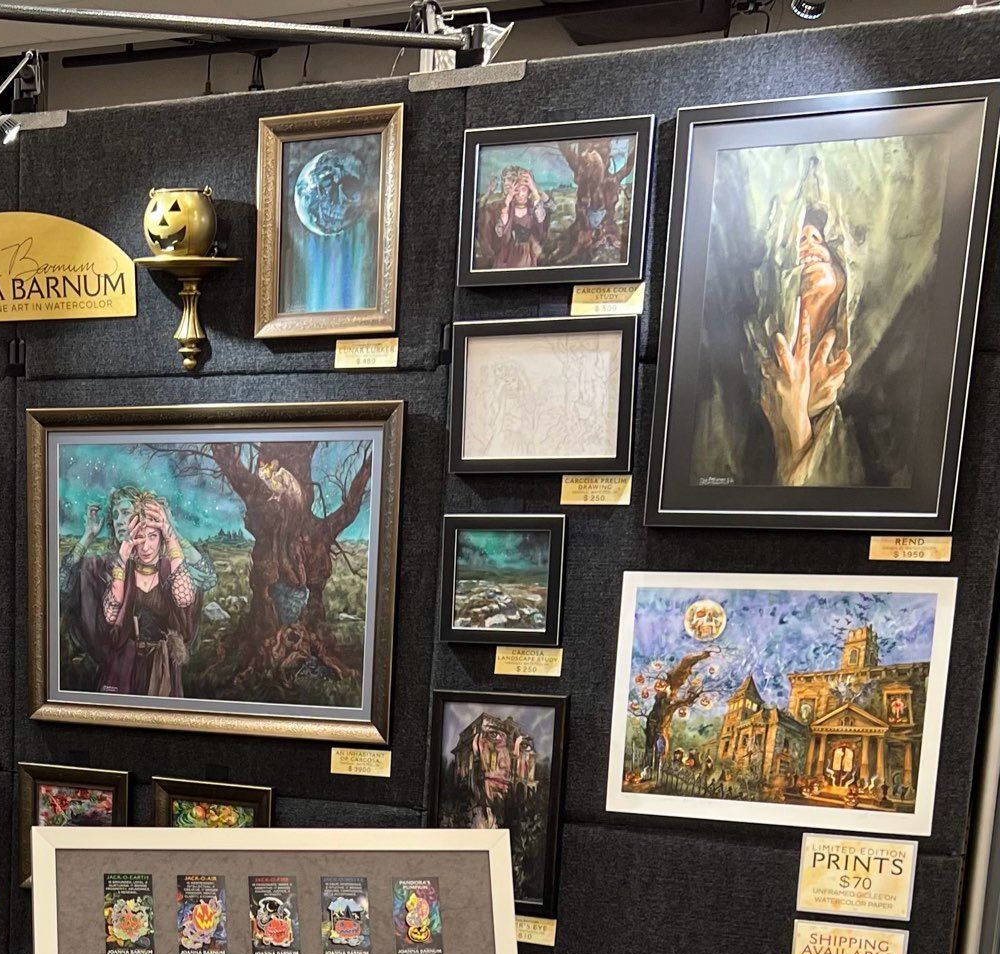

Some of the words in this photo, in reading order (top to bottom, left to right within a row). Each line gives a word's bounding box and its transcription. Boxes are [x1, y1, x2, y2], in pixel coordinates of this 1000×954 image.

[1, 237, 118, 283] Barnum
[12, 272, 127, 301] BARNUM
[11, 303, 29, 313] ART
[32, 302, 42, 312] IN
[44, 299, 114, 311] WATERCOLOR
[894, 538, 925, 546] REND
[812, 844, 856, 855] LIMITED
[860, 848, 906, 858] EDITION
[812, 852, 903, 876] PRINTS
[839, 875, 872, 890] $70
[812, 888, 855, 898] UNFRAMED
[814, 896, 867, 908] WATERCOLOR
[868, 901, 894, 910] PAPER
[809, 932, 890, 952] SHIPPING
